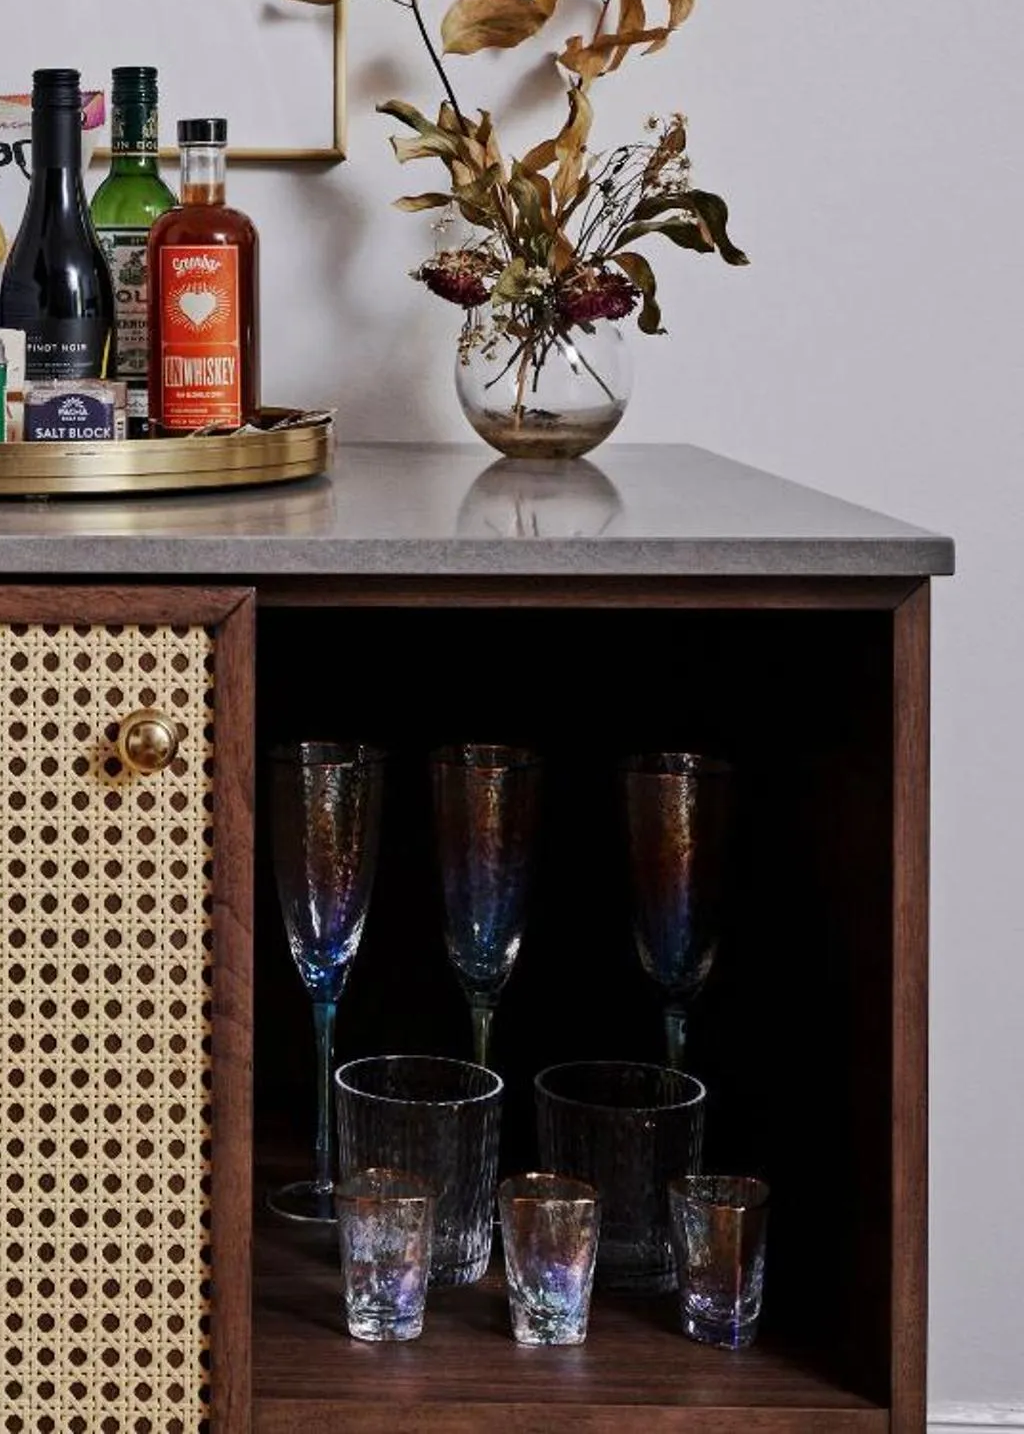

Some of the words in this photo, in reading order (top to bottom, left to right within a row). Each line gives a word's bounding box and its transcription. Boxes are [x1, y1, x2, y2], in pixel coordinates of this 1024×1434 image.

[26, 343, 57, 353] PINOT
[61, 343, 88, 352] NOIR
[35, 427, 66, 439] SALT
[68, 426, 112, 439] BLOCK
